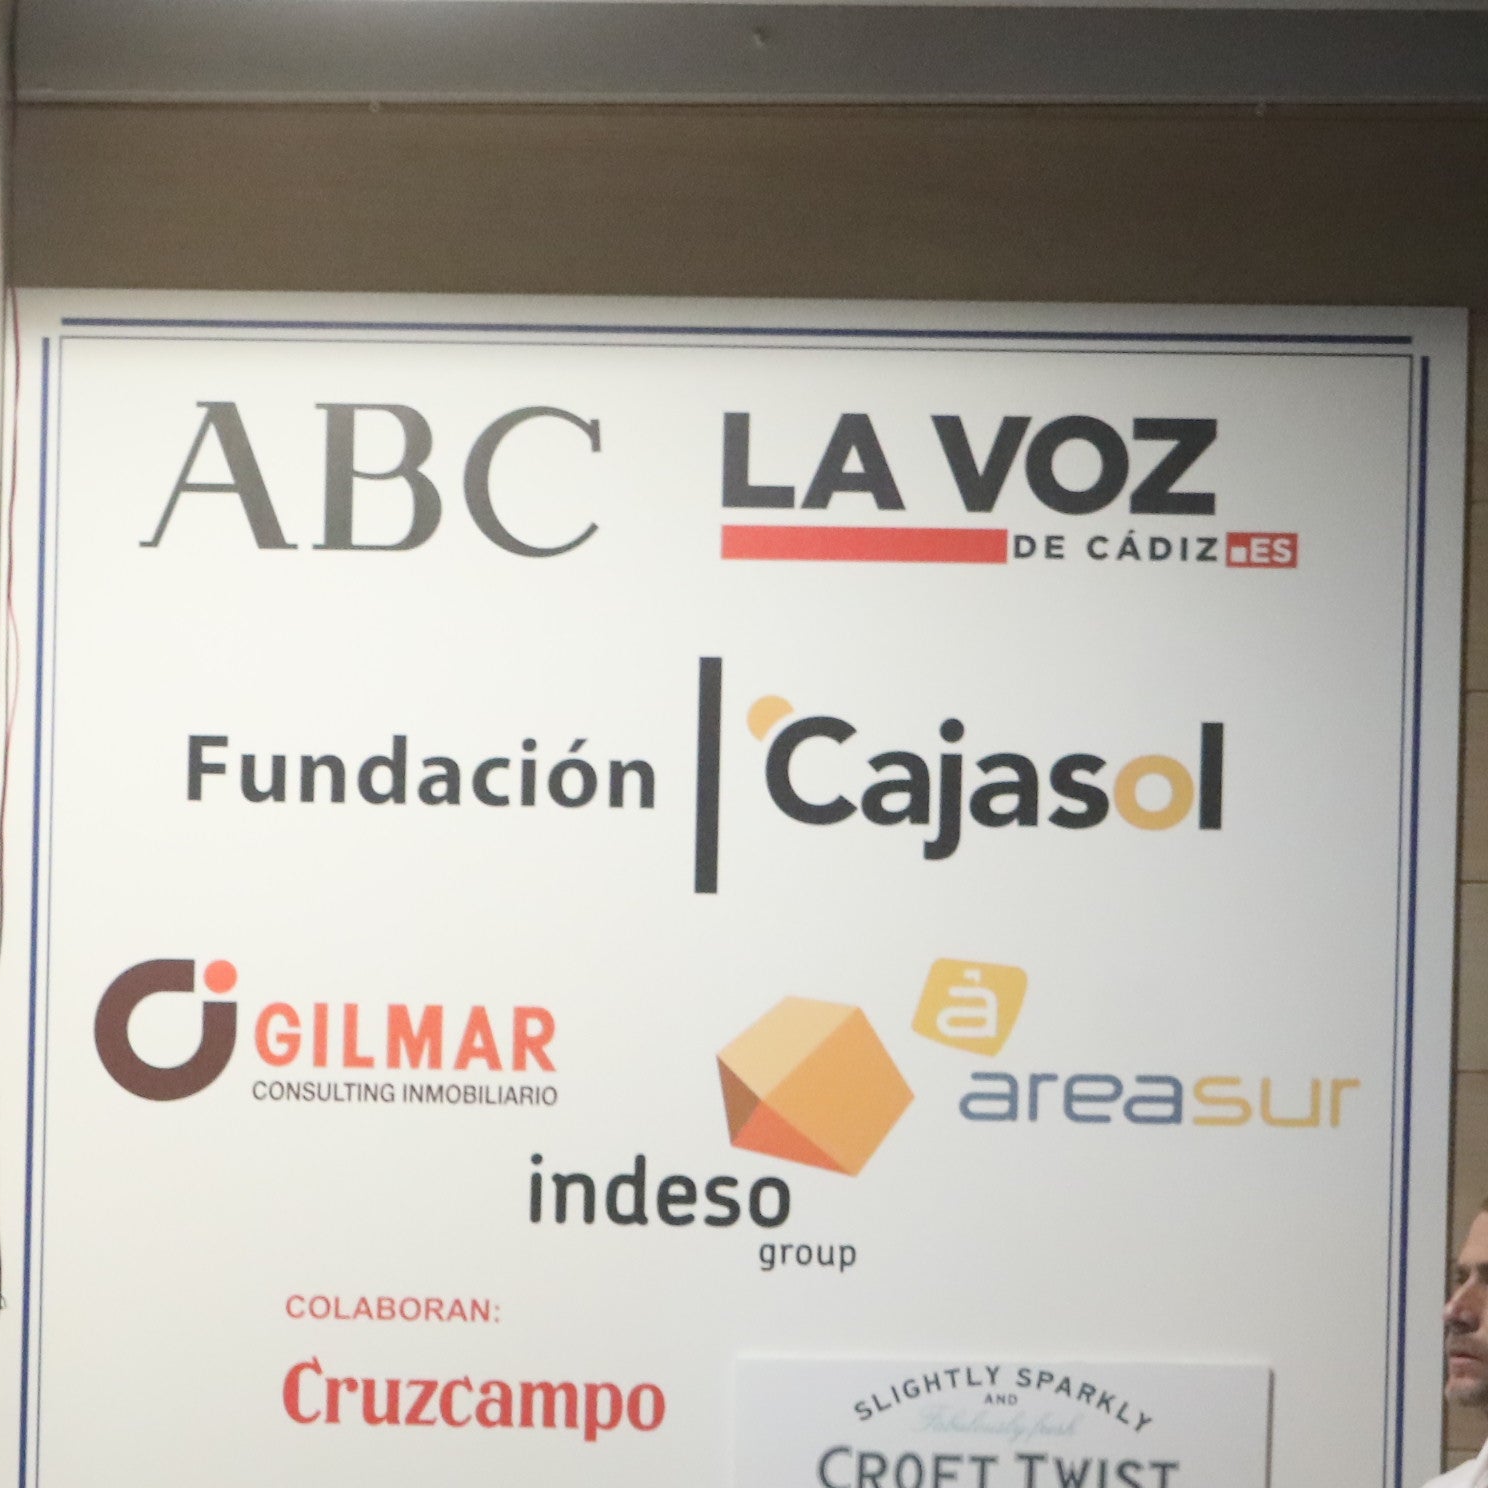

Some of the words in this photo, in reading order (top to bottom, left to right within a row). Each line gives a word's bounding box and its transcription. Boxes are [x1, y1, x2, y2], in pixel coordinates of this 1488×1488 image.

[139, 401, 601, 558] ABC
[722, 412, 906, 510] LA
[932, 415, 1218, 516] VOZ
[1014, 535, 1064, 559] DE
[1087, 529, 1218, 562] CÁDIZ
[188, 735, 655, 809] Fundación
[766, 716, 1224, 860] Cajasol
[255, 1002, 556, 1072] GILMAR
[252, 1080, 395, 1103] CONSULTING
[403, 1084, 558, 1106] INMOBILIARIO
[959, 1070, 1361, 1127] areasur
[530, 1154, 791, 1228] indeso
[759, 1244, 856, 1273] group
[285, 1294, 499, 1323] COLABORAN:
[283, 1357, 666, 1442] Cruzcampo
[854, 1366, 999, 1422] SLIGHTLY
[1016, 1368, 1152, 1433] SPARKLY
[984, 1394, 1017, 1406] AND
